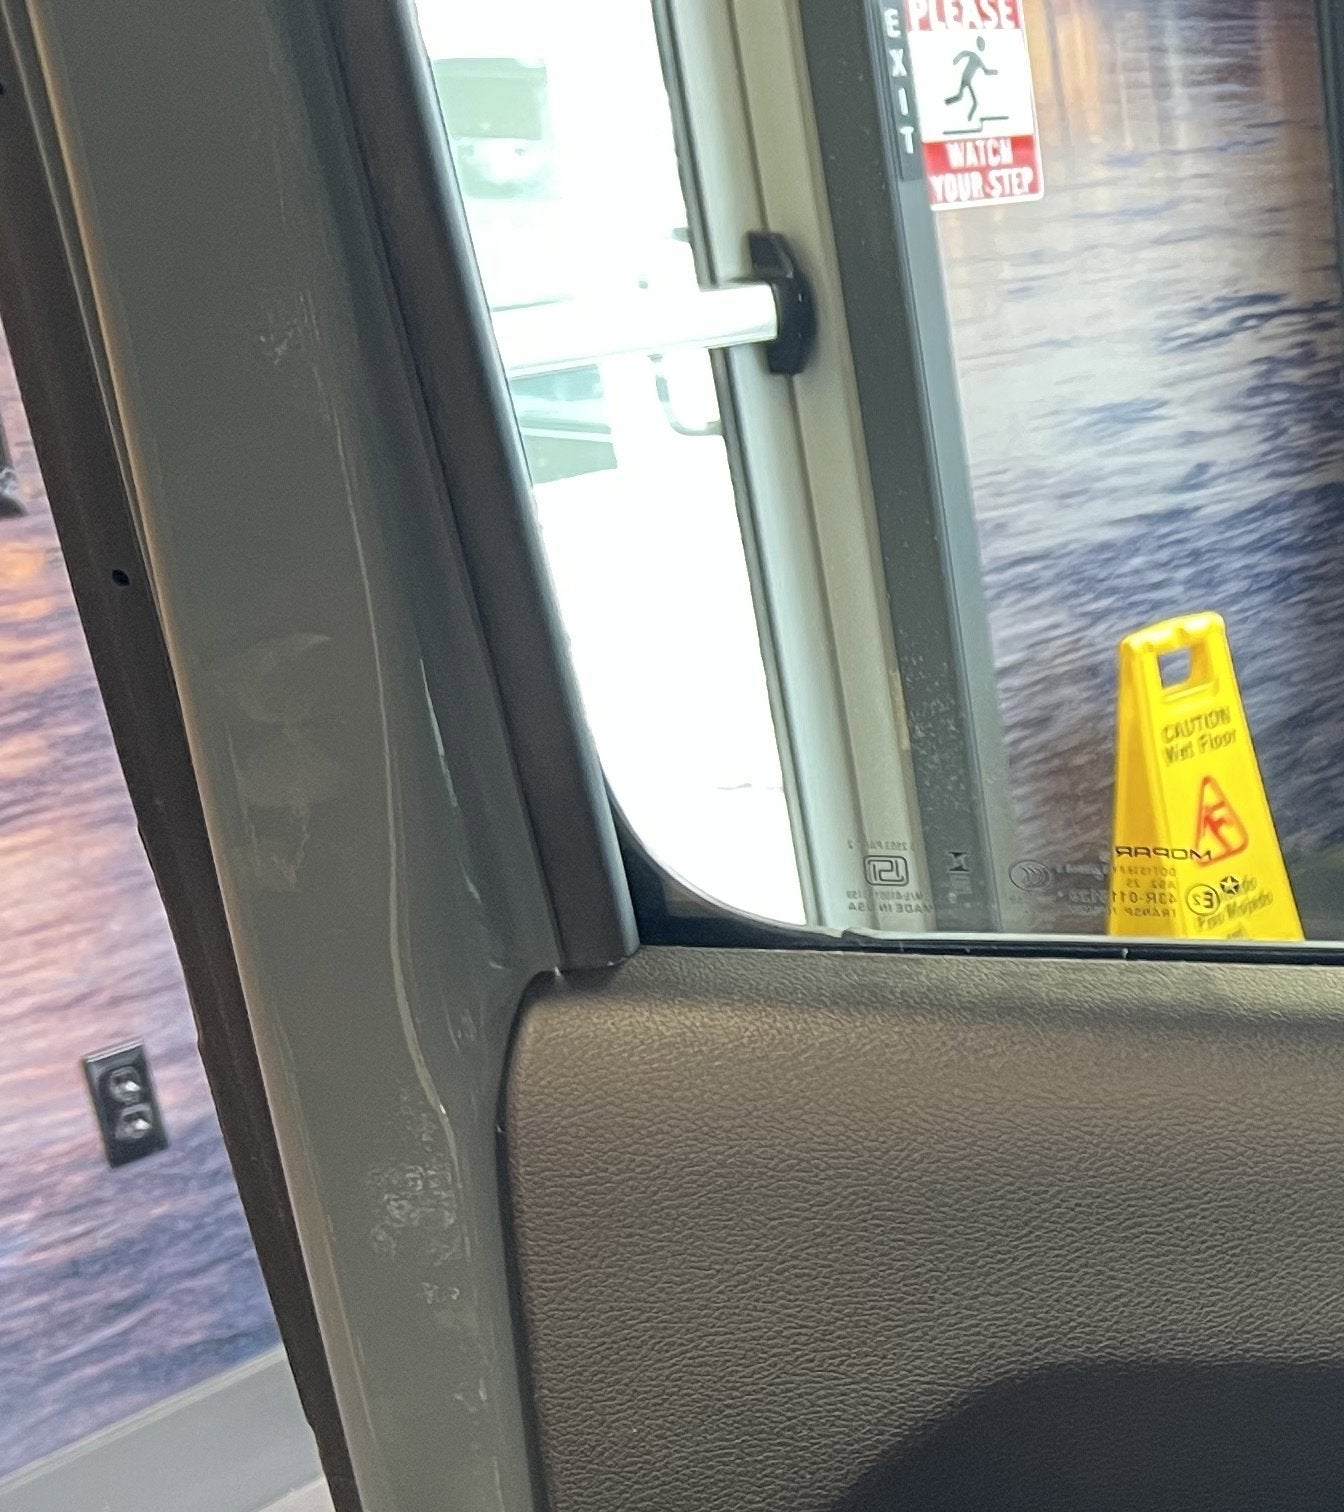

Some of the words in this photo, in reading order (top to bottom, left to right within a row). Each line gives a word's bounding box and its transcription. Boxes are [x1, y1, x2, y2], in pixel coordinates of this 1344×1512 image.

[906, 0, 1017, 31] PLEASE
[884, 8, 915, 154] EXIT
[944, 137, 1014, 169] WATCH
[929, 171, 984, 204] YOUR
[985, 166, 1034, 198] STEP
[1162, 706, 1231, 743] CAUTION
[1197, 729, 1237, 754] Floor
